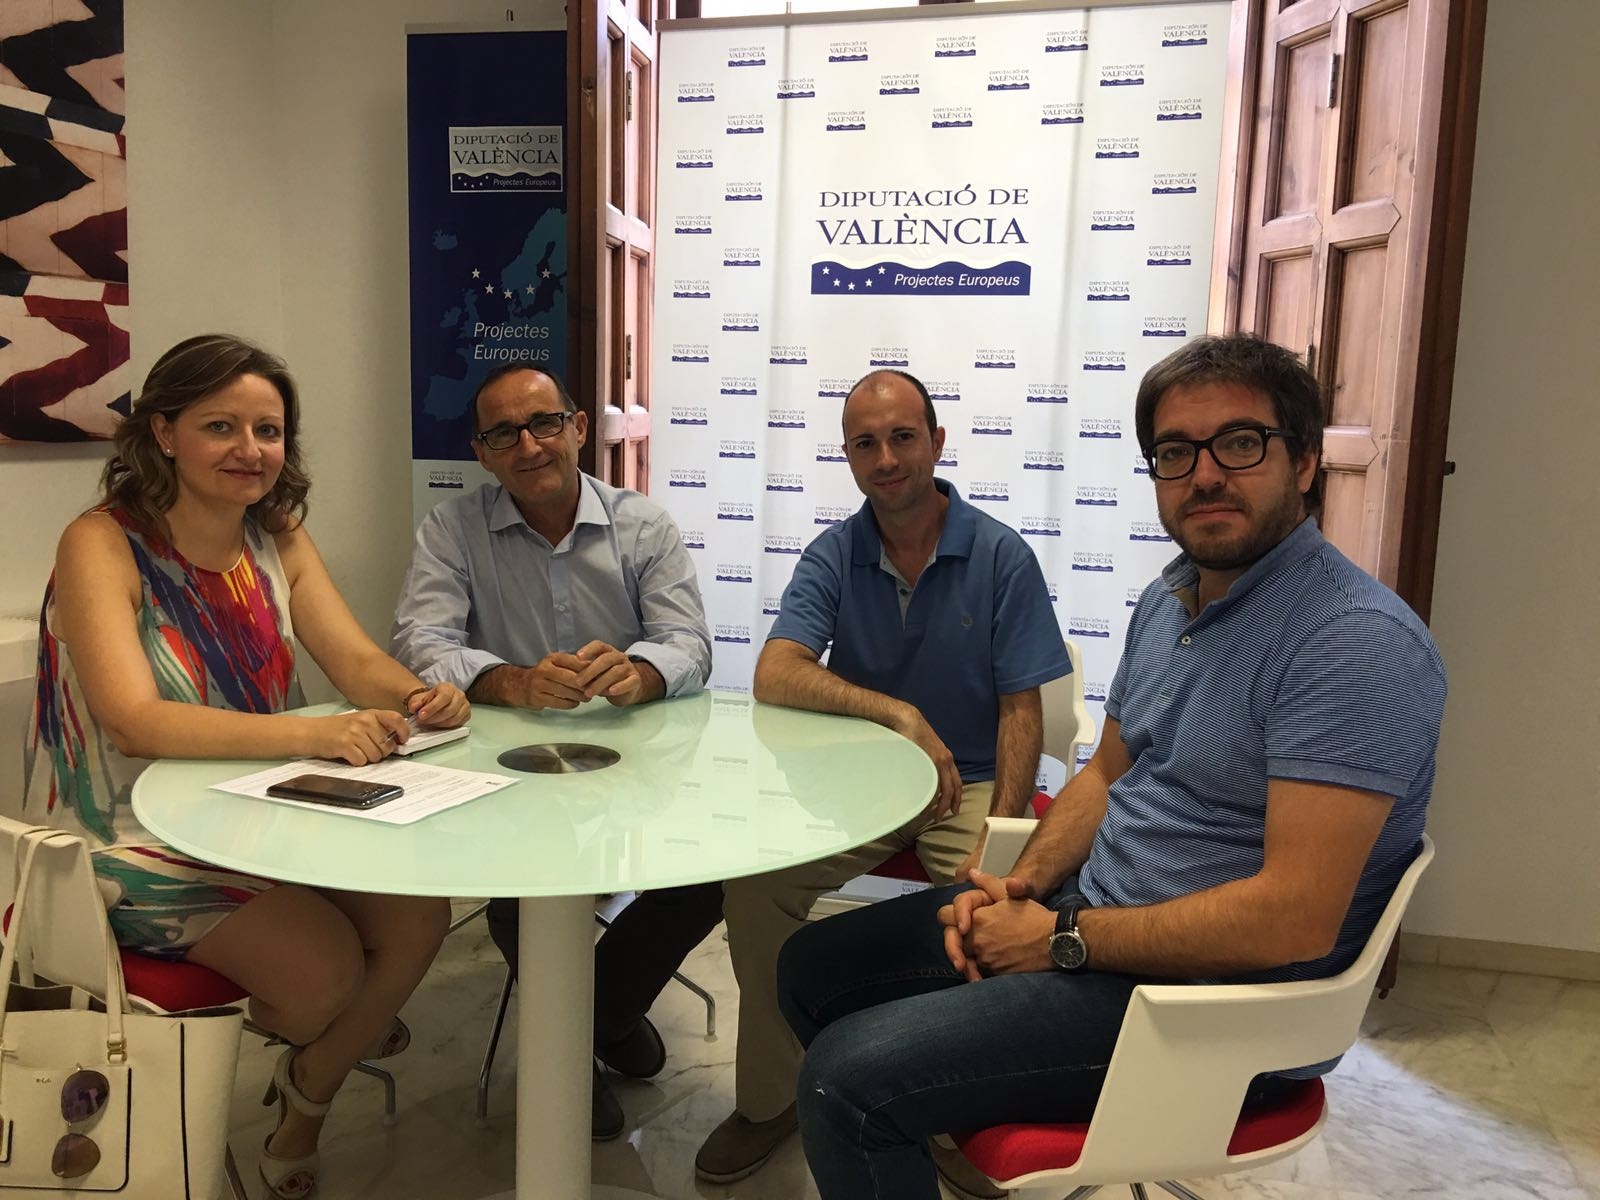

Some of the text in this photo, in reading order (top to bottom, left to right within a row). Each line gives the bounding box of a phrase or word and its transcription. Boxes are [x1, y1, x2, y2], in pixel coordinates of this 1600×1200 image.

[453, 132, 558, 144] DIPUTACIÓ DE
[453, 146, 559, 165] VALÈNCIA
[493, 178, 556, 187] Projectes Europeus
[819, 184, 1029, 207] DIPUTACIÓ DE
[816, 213, 1029, 245] VALÈNCIA
[894, 274, 1020, 288] Projectes Europeus
[474, 322, 550, 341] Projectes
[474, 344, 550, 362] Europeus
